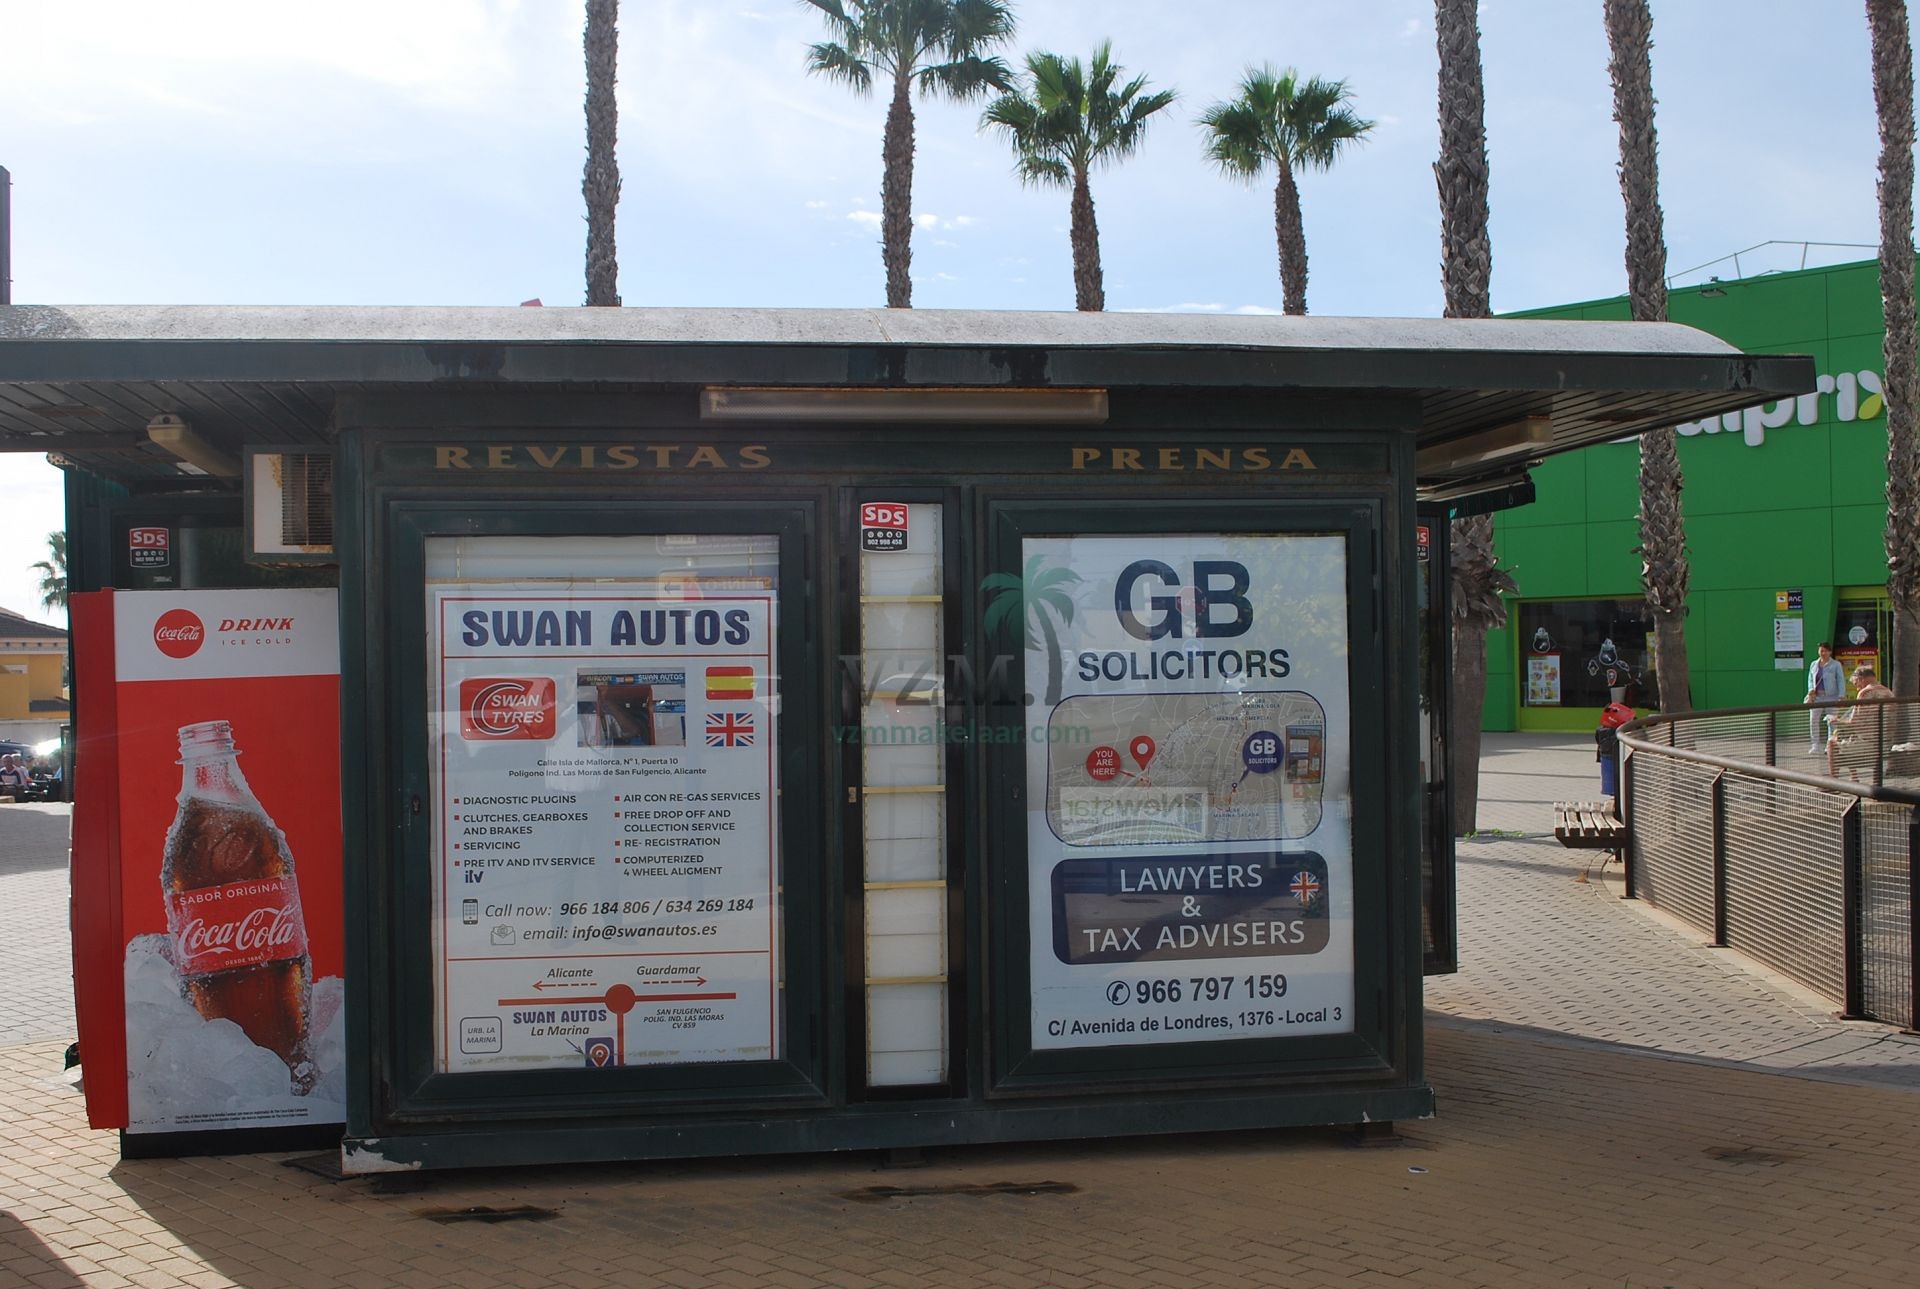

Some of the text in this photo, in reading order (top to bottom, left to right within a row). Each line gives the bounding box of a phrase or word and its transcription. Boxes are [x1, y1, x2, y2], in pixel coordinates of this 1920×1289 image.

[434, 445, 772, 470] REVISTAS
[1071, 447, 1318, 470] PRENSA
[864, 506, 905, 526] SDS
[132, 531, 166, 547] SDS
[1114, 558, 1254, 642] GB
[217, 617, 295, 632] DRINK
[461, 608, 751, 648] SWAN AUTOS
[156, 625, 201, 641] Coca-Cola
[1077, 648, 1291, 682] SOLICITORS
[491, 694, 541, 707] SWAN
[491, 711, 545, 723] TYRES
[1249, 739, 1277, 755] GB
[1095, 750, 1114, 759] YOU
[537, 759, 557, 767] Calle
[559, 758, 572, 766] Isla
[574, 758, 585, 766] de
[586, 758, 622, 767] Mallorca,
[642, 757, 667, 766] Puerta
[1095, 758, 1114, 767] ARE
[1248, 757, 1278, 765] SOLICITORS
[546, 769, 562, 777] Ind.
[577, 768, 601, 777] Moras
[614, 768, 630, 776] San
[631, 767, 673, 778] Fulgencio,
[674, 767, 707, 775] Alicante
[1092, 767, 1116, 776] HERE
[463, 794, 577, 805] DIAGNOSTIC PLUGINS
[623, 792, 761, 803] AIR CON RE-GAS SERVICES
[463, 812, 589, 824] CLUTCHES, GEARBOXES
[624, 809, 731, 819] FREE DROP OFF AND
[463, 825, 533, 836] AND BRAKES
[623, 822, 736, 833] COLLECTION SERVICE
[463, 841, 521, 851] SERVICING
[644, 837, 721, 847] REGISTRATION
[464, 856, 596, 868] PRE ITV AND ITV SERVICE
[623, 854, 704, 865] COMPUTERIZED
[623, 866, 723, 877] 4 WHEEL ALIGMENT
[1119, 863, 1264, 893] LAWYERS
[178, 881, 288, 907] SABOR ORIGINAL
[485, 898, 754, 917] Call now: 966 184 806 / 634 269 184
[1181, 895, 1202, 918] &
[177, 904, 299, 959] Coca-Cola
[523, 924, 718, 942] email: info@swanautos.es
[1082, 919, 1306, 953] TAX ADVISERS
[546, 967, 594, 979] Alicante
[636, 964, 702, 976] Guardamar
[1135, 973, 1288, 1005] 966 797 159
[512, 1008, 608, 1025] SWAN AUTOS
[656, 1007, 712, 1016] SAN FULGENCIO
[698, 1013, 725, 1021] MORAS
[1047, 1019, 1066, 1037] C/
[1070, 1015, 1136, 1036] Avenida
[1139, 1015, 1160, 1032] de
[1163, 1011, 1233, 1031] Londres,
[1237, 1010, 1275, 1027] 1376
[1333, 1006, 1343, 1021] 3
[467, 1026, 496, 1035] URB. LA
[530, 1024, 590, 1037] La Marina
[466, 1036, 497, 1044] MARINA
